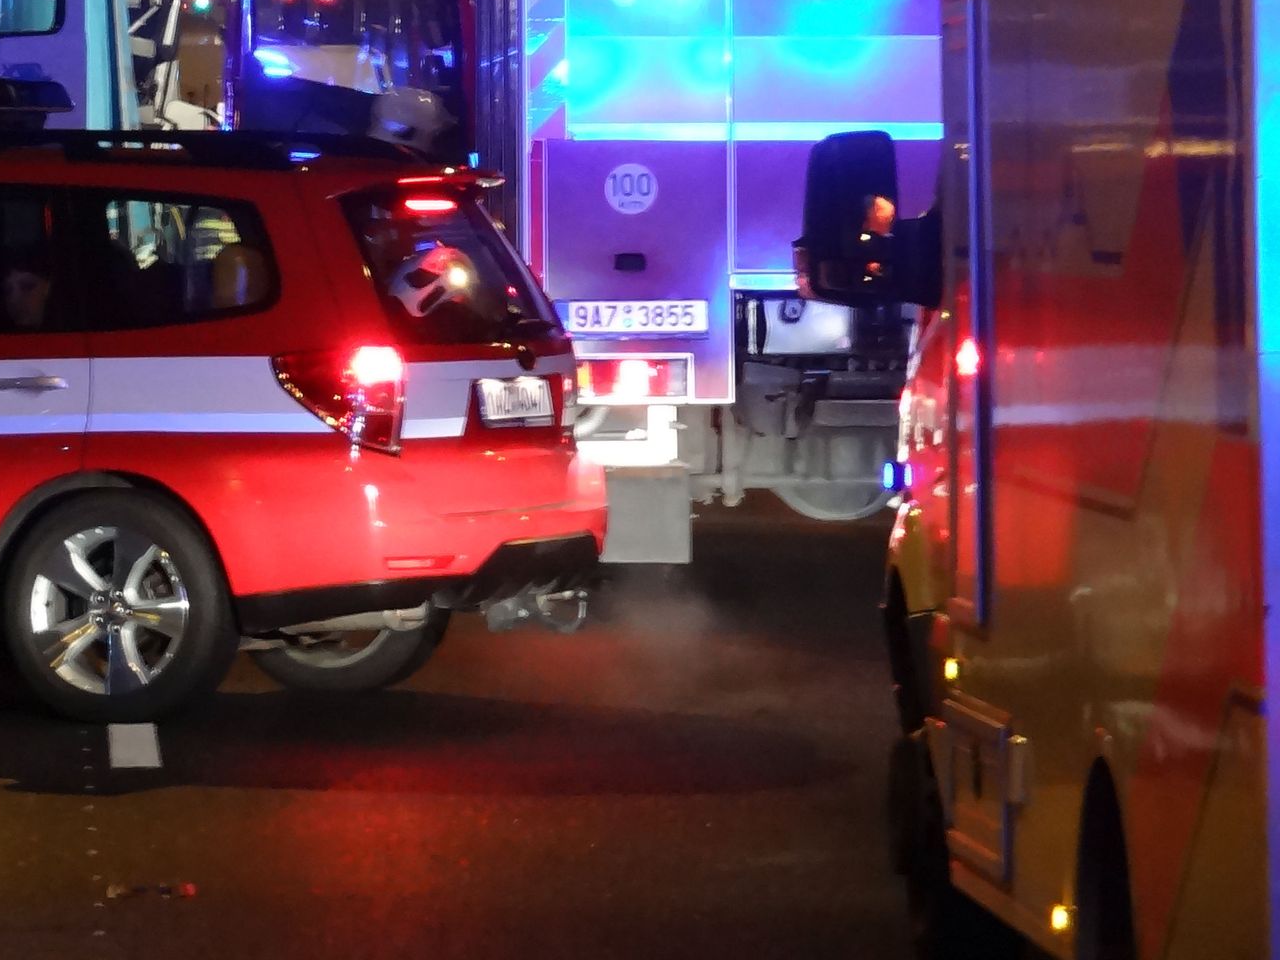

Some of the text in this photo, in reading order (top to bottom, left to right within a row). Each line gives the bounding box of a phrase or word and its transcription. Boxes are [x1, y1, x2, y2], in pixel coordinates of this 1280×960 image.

[610, 173, 651, 196] 100
[574, 304, 695, 328] 9A7 3855
